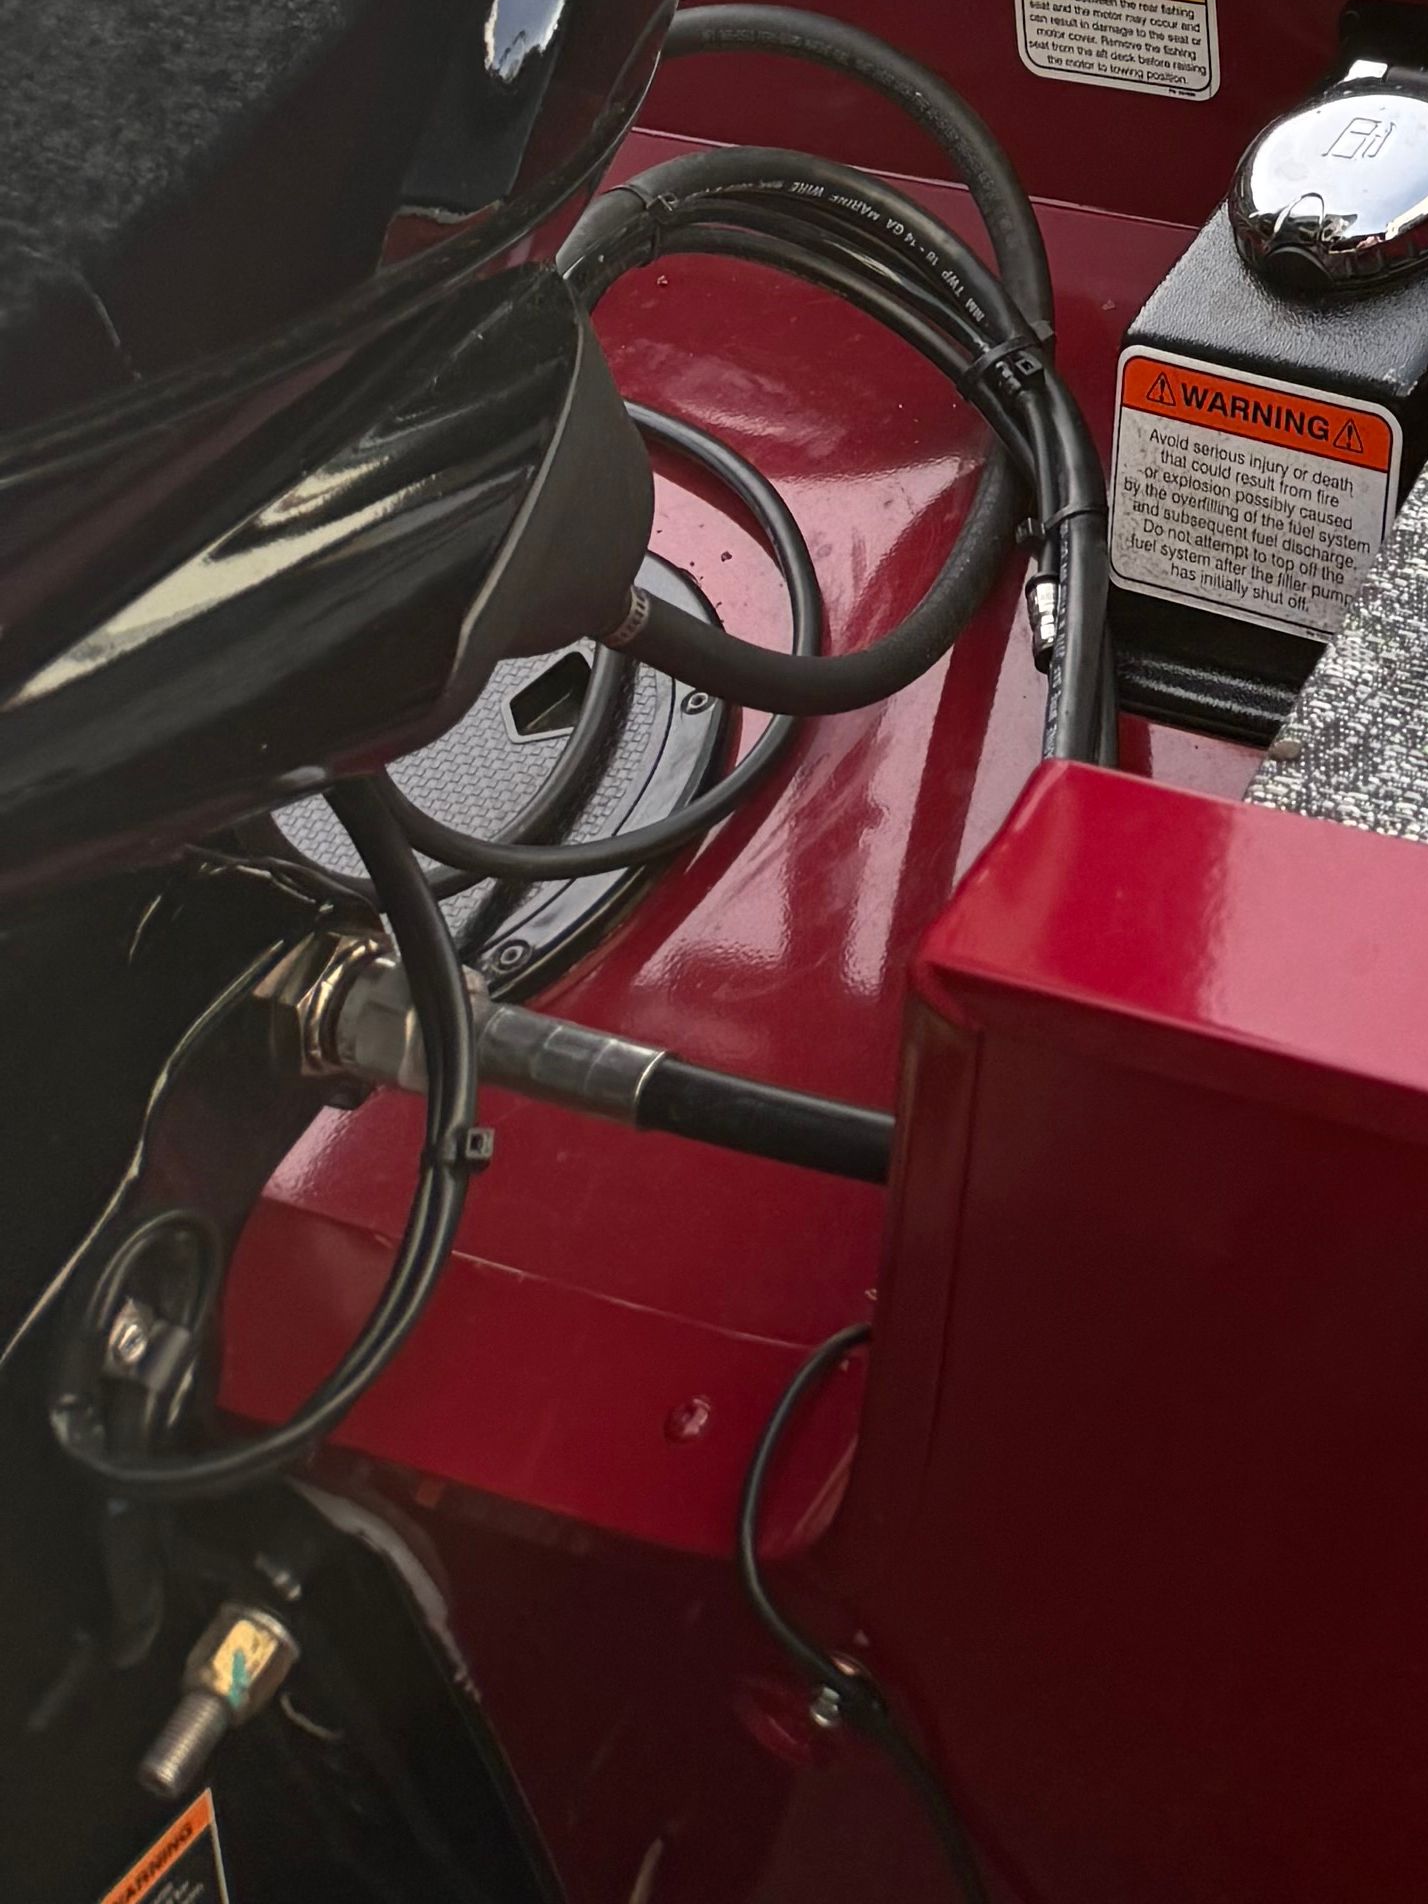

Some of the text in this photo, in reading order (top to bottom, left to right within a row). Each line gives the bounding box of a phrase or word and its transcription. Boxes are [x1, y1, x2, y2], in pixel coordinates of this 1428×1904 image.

[1030, 14, 1047, 24] can
[1051, 16, 1078, 28] result
[1080, 20, 1089, 30] in
[1092, 22, 1133, 37] damage
[1136, 28, 1146, 38] to
[1149, 29, 1165, 41] the
[1168, 33, 1188, 45] seat
[1053, 3, 1071, 13] and
[1074, 5, 1089, 16] the
[1093, 9, 1122, 21] motor
[1125, 14, 1146, 26] may
[1150, 18, 1177, 29] occur
[1181, 20, 1200, 32] and
[1139, 2, 1158, 12] rear
[1161, 4, 1194, 20] fishing
[1036, 28, 1196, 61] motor cover. Remove the fishing
[1052, 41, 1074, 53] from
[1077, 46, 1093, 56] the
[1111, 50, 1135, 63] deck
[1138, 54, 1170, 68] before
[1173, 61, 1206, 76] raising
[1047, 55, 1188, 84] the motor to towing position.
[792, 182, 824, 198] WIRE
[829, 194, 881, 221] MARINE
[886, 218, 904, 235] GA
[1181, 383, 1329, 442] WARNING
[1150, 428, 1354, 493] Avoid serious injury or death
[1160, 449, 1340, 508] that could result from fire
[1124, 477, 1371, 554] by the overfilling of the fuel system
[1144, 466, 1353, 530] or explosion possibly caused
[1132, 500, 1357, 570] and subsequent fuel discharge.
[1143, 518, 1344, 585] Do not attempt to top off the
[1131, 535, 1354, 610] fuel system after the filler pump
[1170, 562, 1309, 613] has initially shut off.
